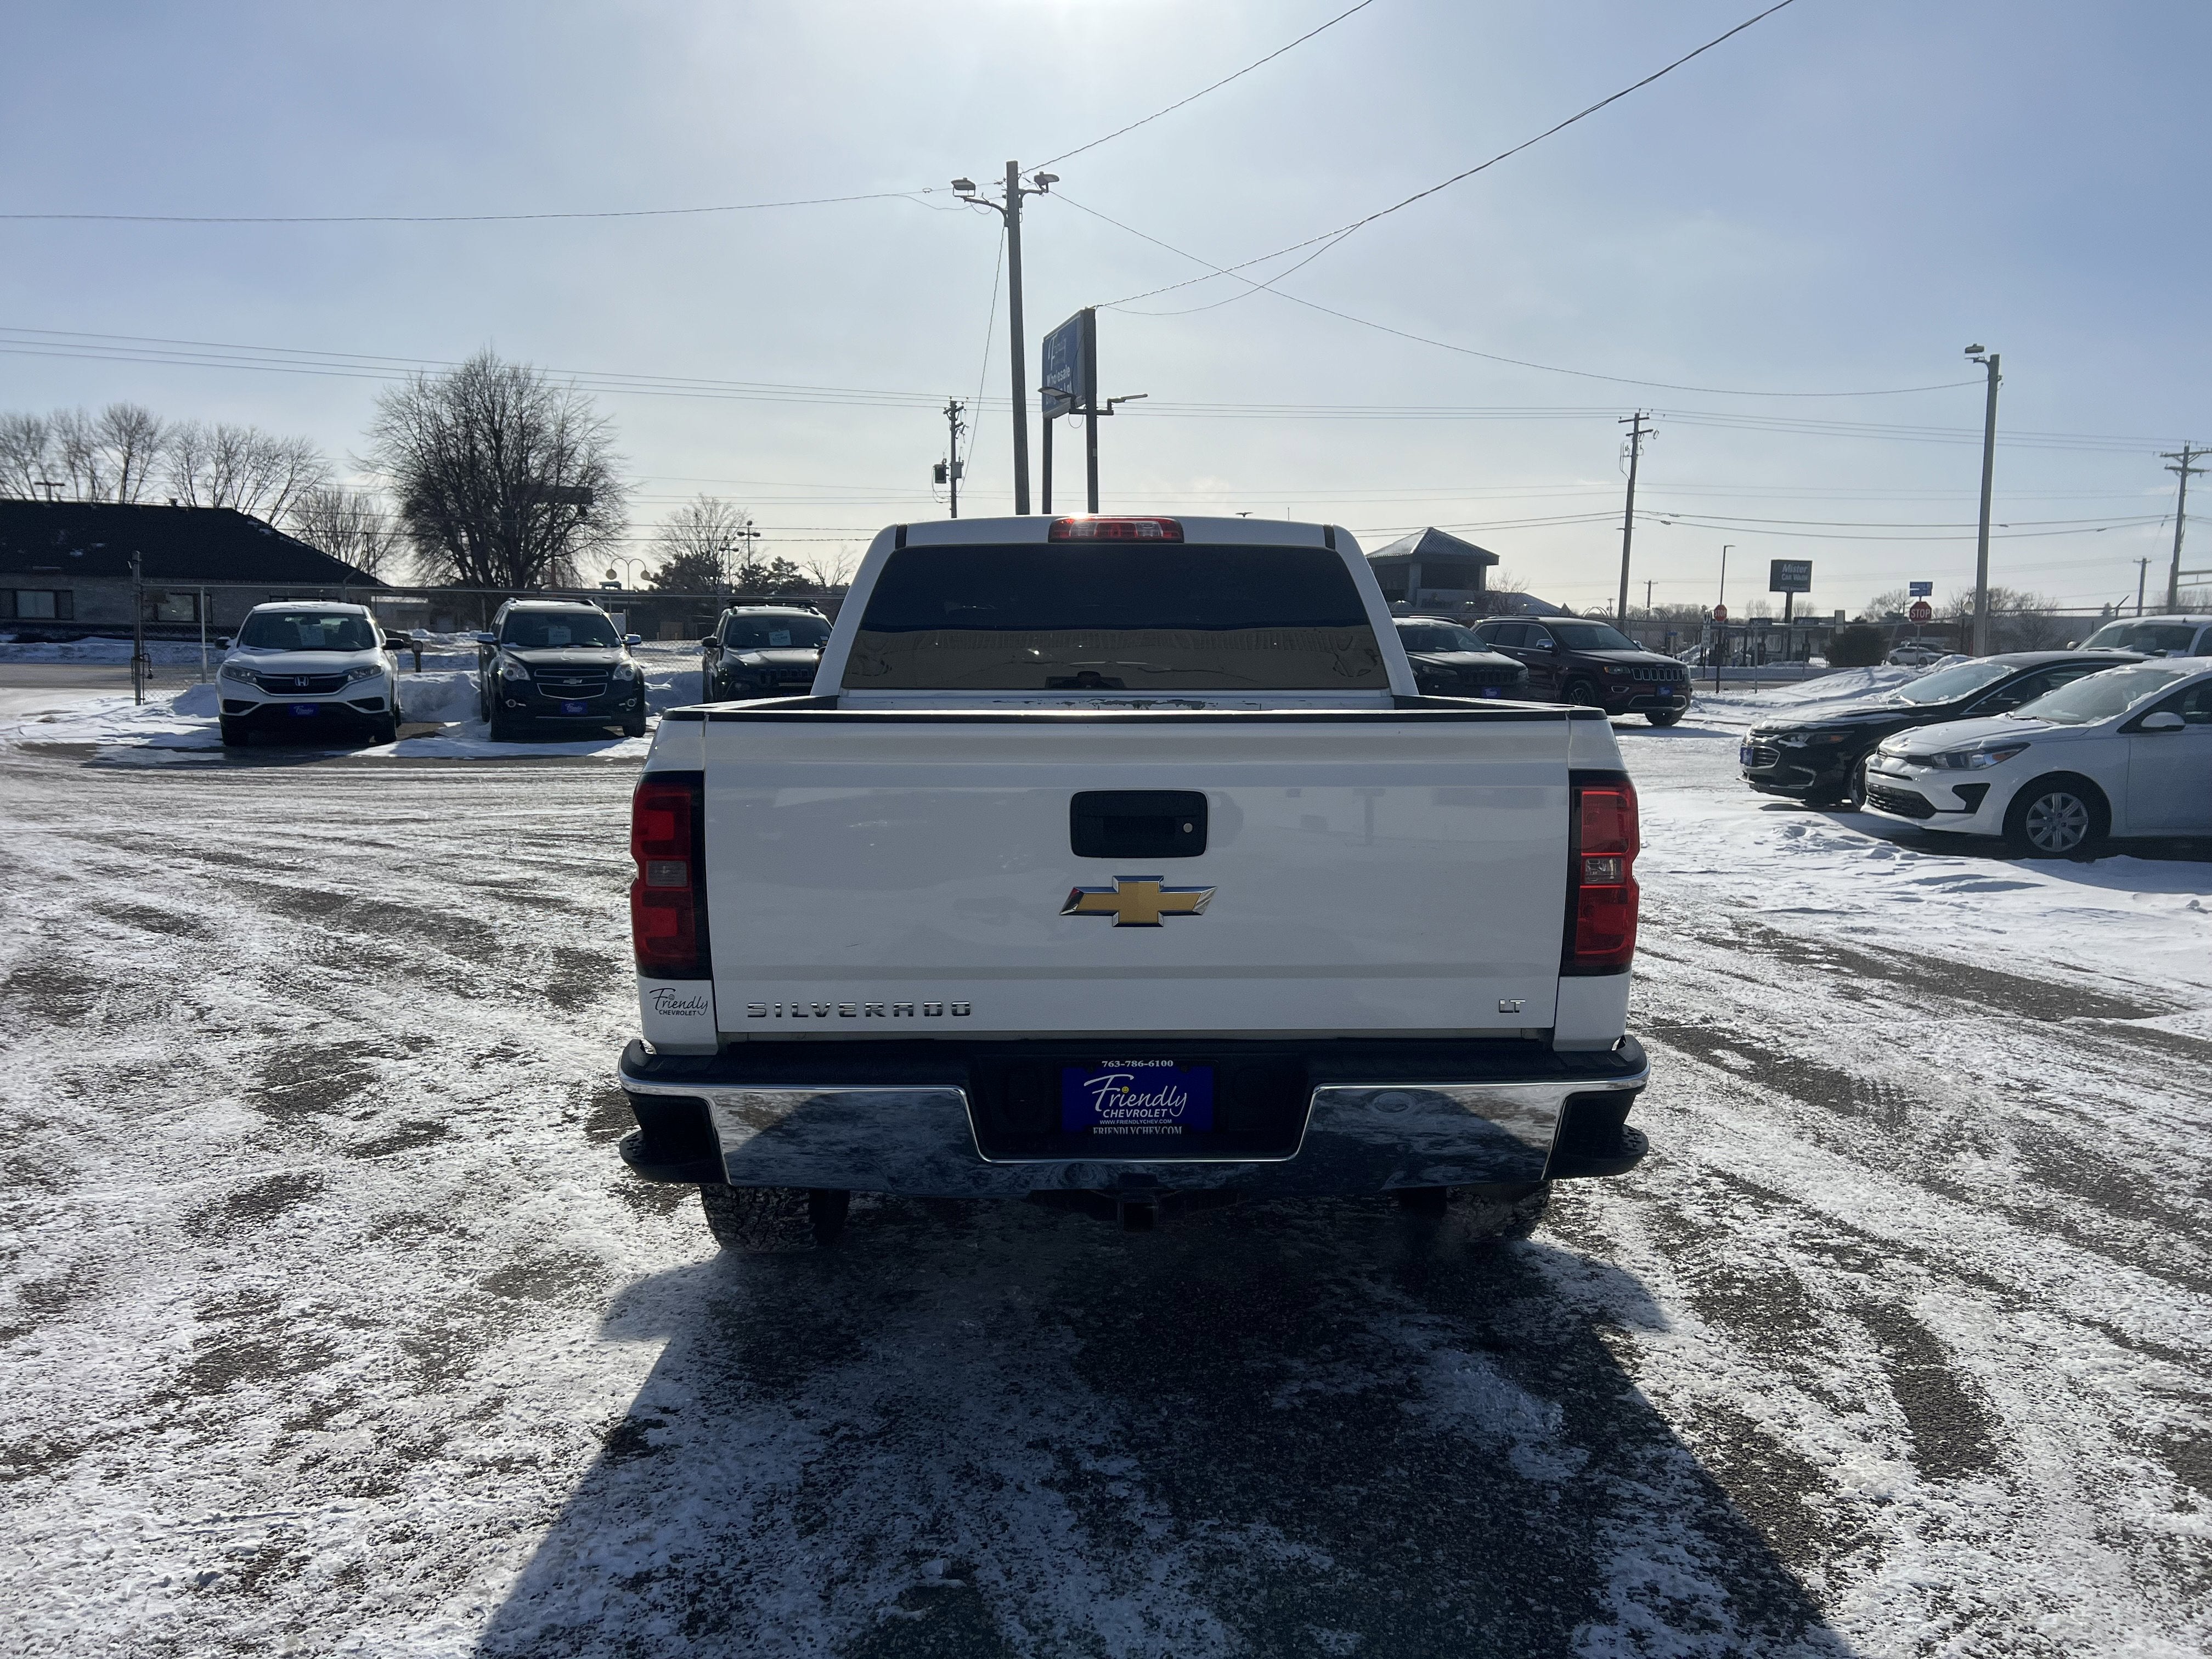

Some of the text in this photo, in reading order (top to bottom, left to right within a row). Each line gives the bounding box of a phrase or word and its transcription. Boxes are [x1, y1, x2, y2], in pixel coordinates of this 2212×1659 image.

[1781, 563, 1808, 573] Mister
[1714, 609, 1727, 617] STOP
[1910, 608, 1931, 618] STOP
[649, 988, 708, 1016] Friendly
[1499, 999, 1526, 1013] LT
[747, 1001, 971, 1018] SILVERADO
[1084, 1074, 1187, 1117] Friendly
[1103, 1109, 1167, 1118] CHEVROLET
[1093, 1126, 1182, 1135] FRIENDLYCHEV.COM
